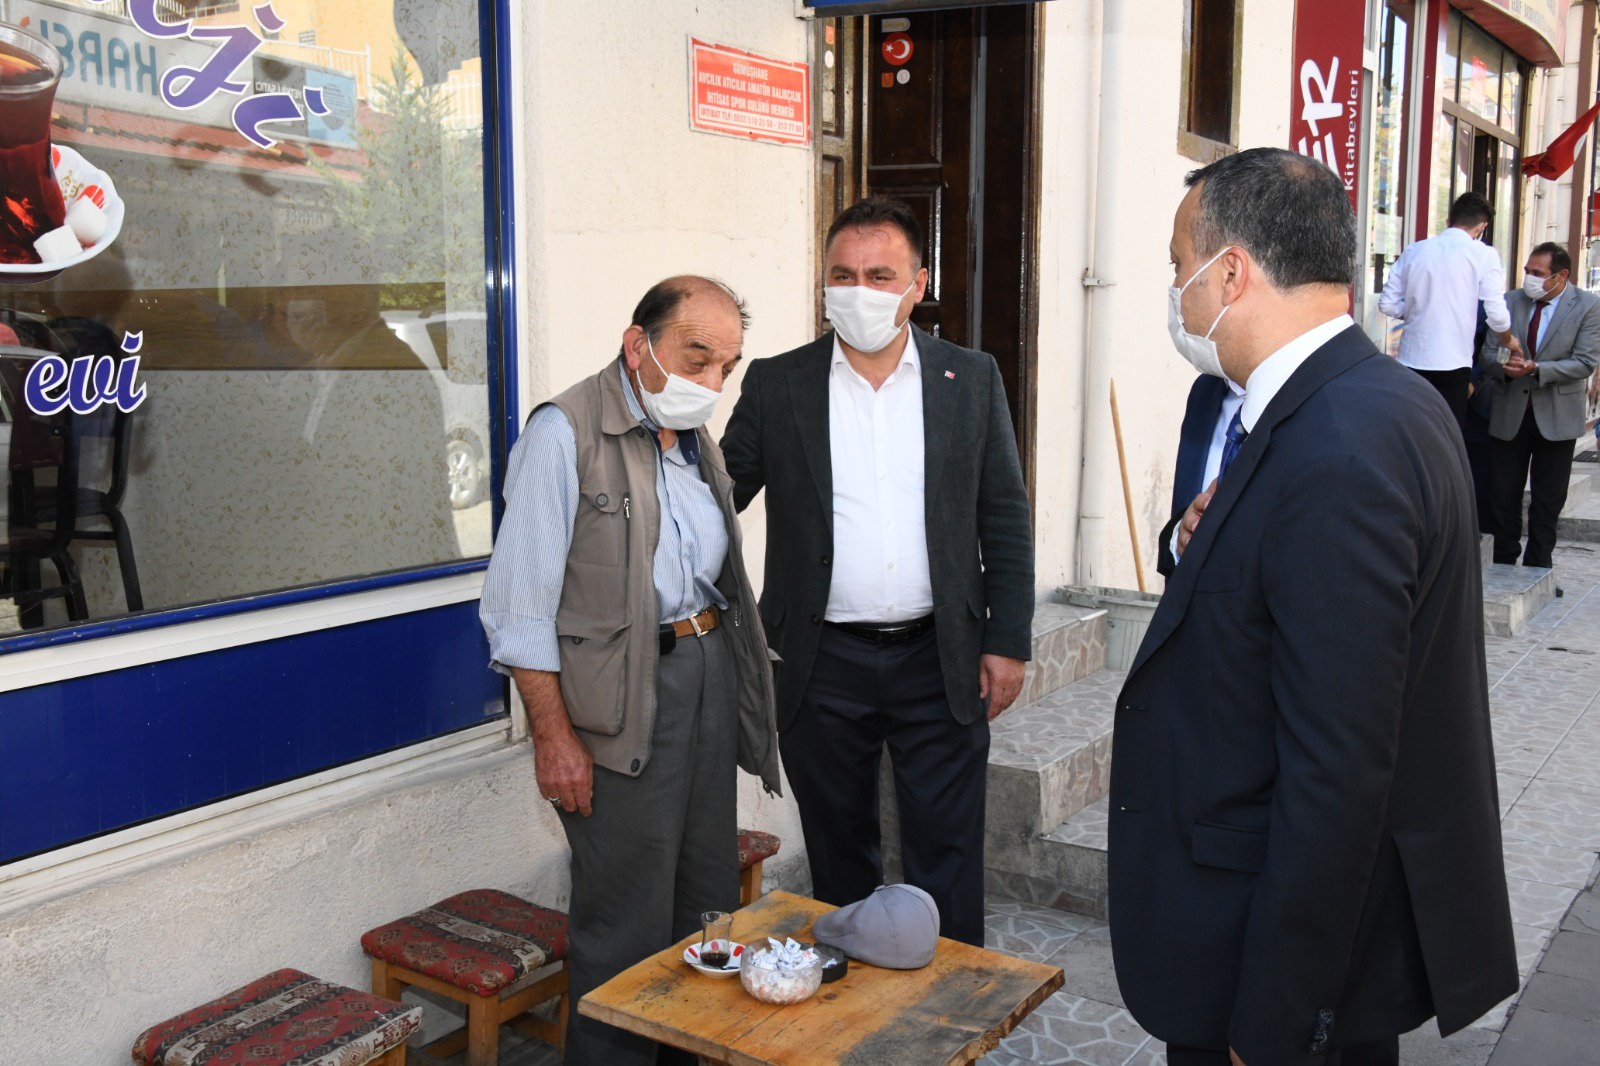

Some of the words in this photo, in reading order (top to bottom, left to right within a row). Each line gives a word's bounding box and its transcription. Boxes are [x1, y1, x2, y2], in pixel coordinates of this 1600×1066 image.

[699, 71, 721, 87] AVCILIK
[723, 76, 746, 92] ATICILIK
[748, 79, 771, 97] AMATÖR
[772, 85, 802, 104] BALIKÇILIK
[733, 61, 769, 81] GÜMÜŞHANE
[706, 88, 729, 106] İHTİSAS
[731, 95, 746, 110] SPOR
[748, 98, 769, 114] KULÜBÜ
[770, 102, 794, 118] DERNEĞİ
[1344, 69, 1359, 191] Kitabevleri
[24, 330, 147, 416] evi
